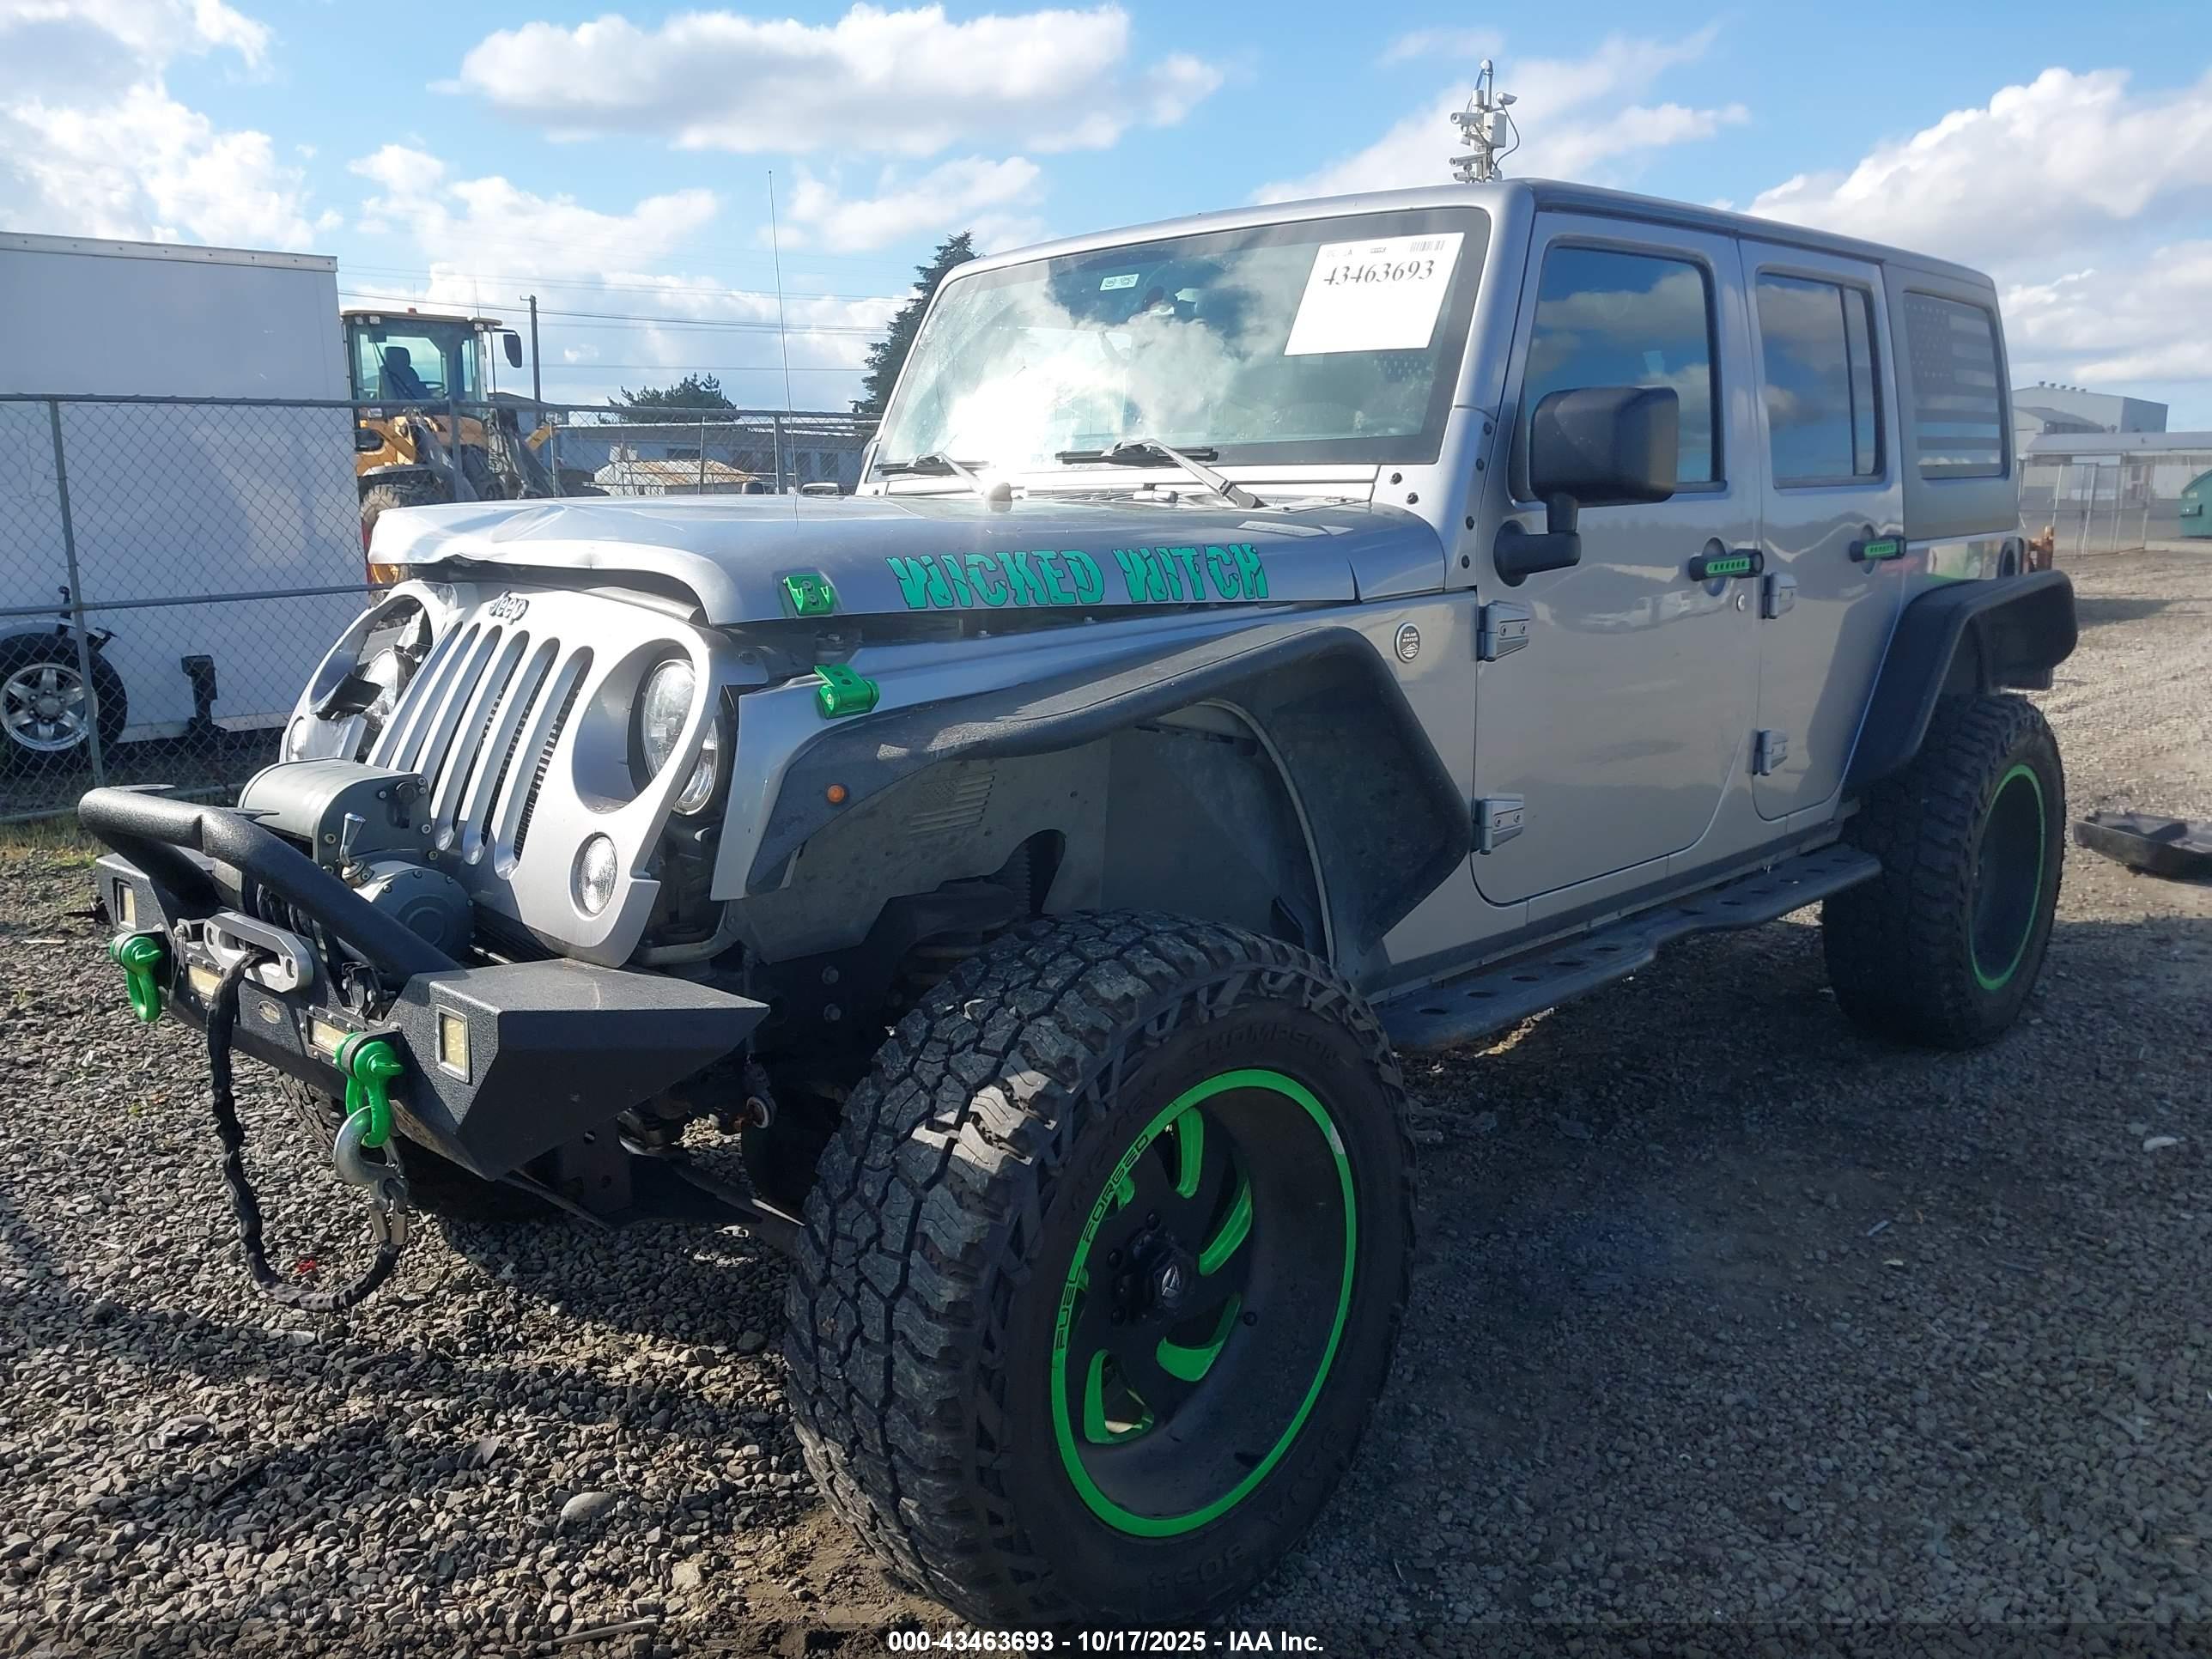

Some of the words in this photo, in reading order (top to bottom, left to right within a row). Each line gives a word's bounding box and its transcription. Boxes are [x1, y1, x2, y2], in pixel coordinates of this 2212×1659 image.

[1323, 259, 1435, 286] 43463693
[885, 549, 1105, 609] WICKED
[1113, 543, 1270, 604] WITCH
[489, 590, 530, 625] Jeep
[1055, 1266, 1082, 1351] FUEL
[1082, 1134, 1149, 1244] FORGED
